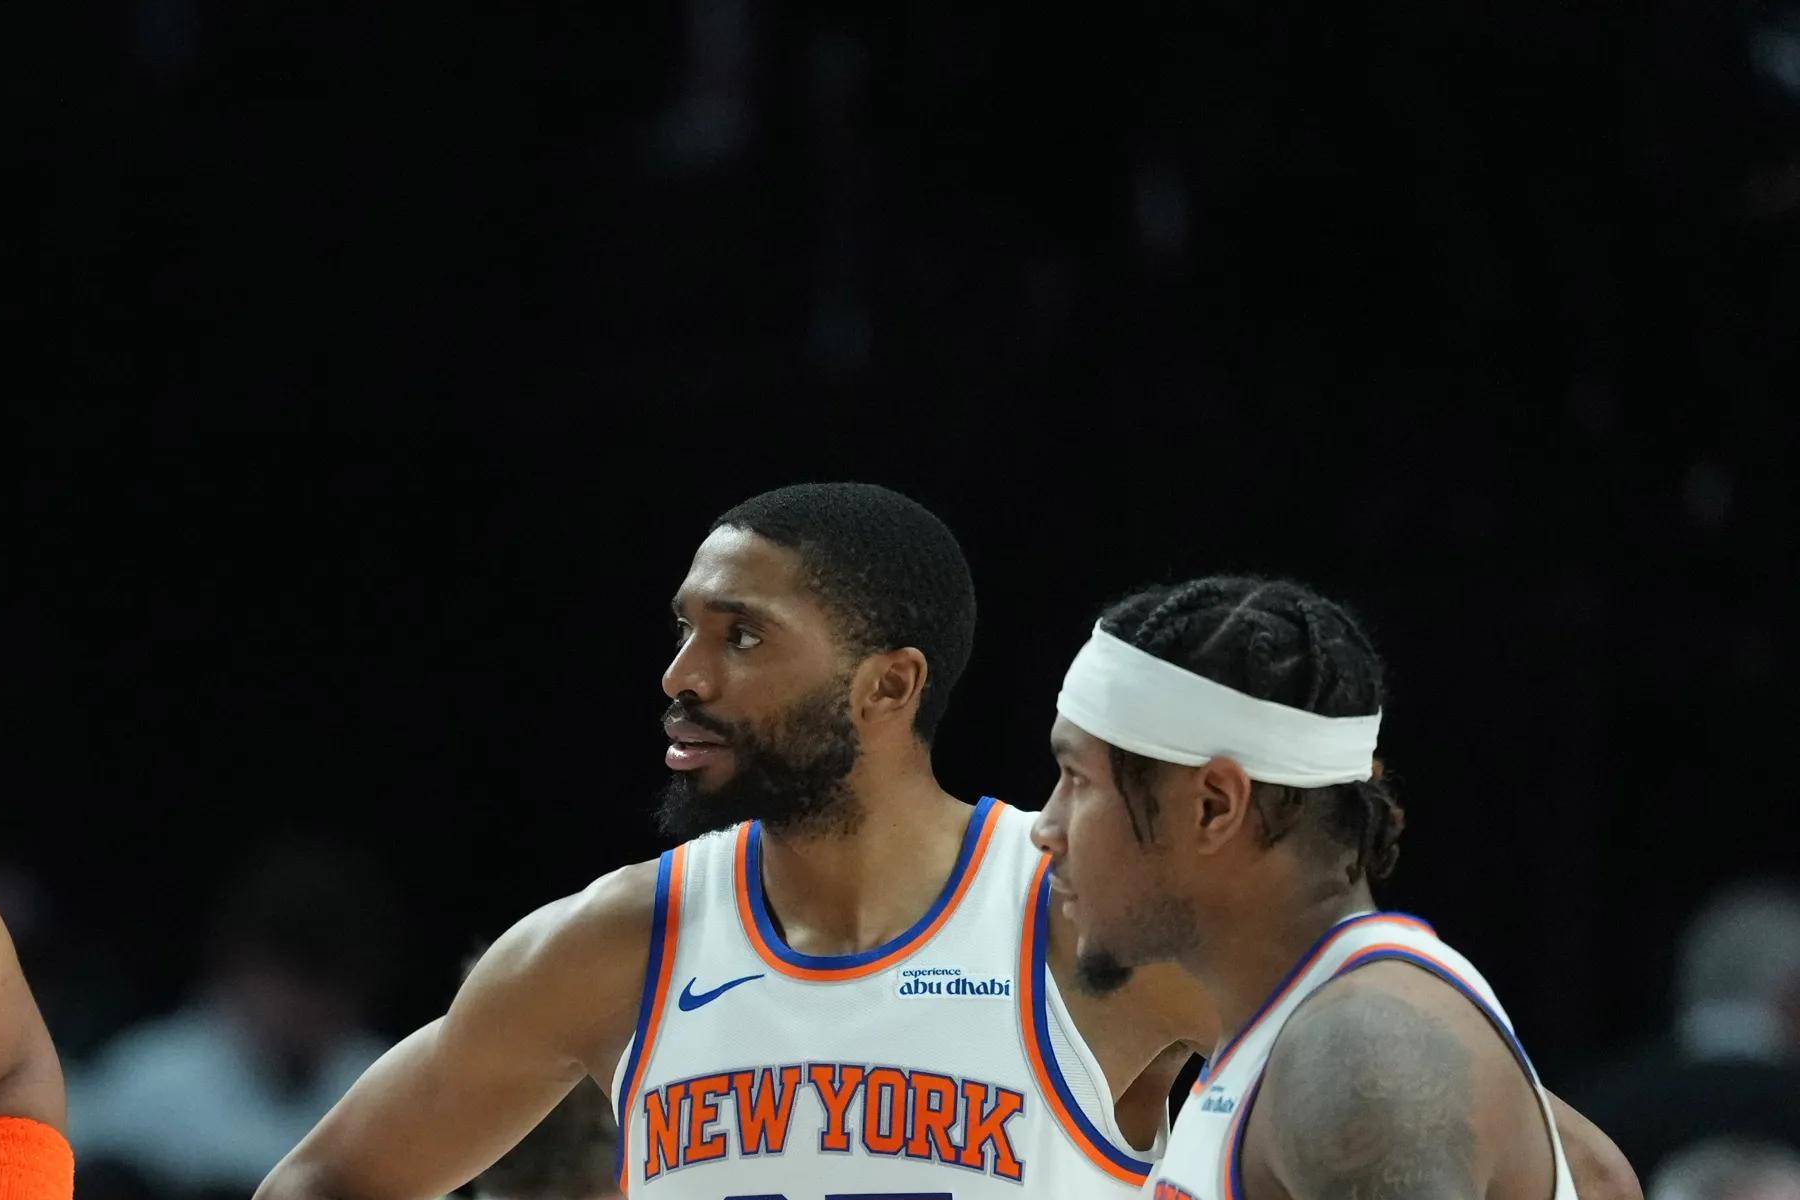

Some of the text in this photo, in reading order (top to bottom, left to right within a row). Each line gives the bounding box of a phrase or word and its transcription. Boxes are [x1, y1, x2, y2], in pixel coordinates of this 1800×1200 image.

[902, 967, 961, 977] experience
[899, 978, 1011, 996] abu dhabi
[643, 1061, 1027, 1185] NEW YORK
